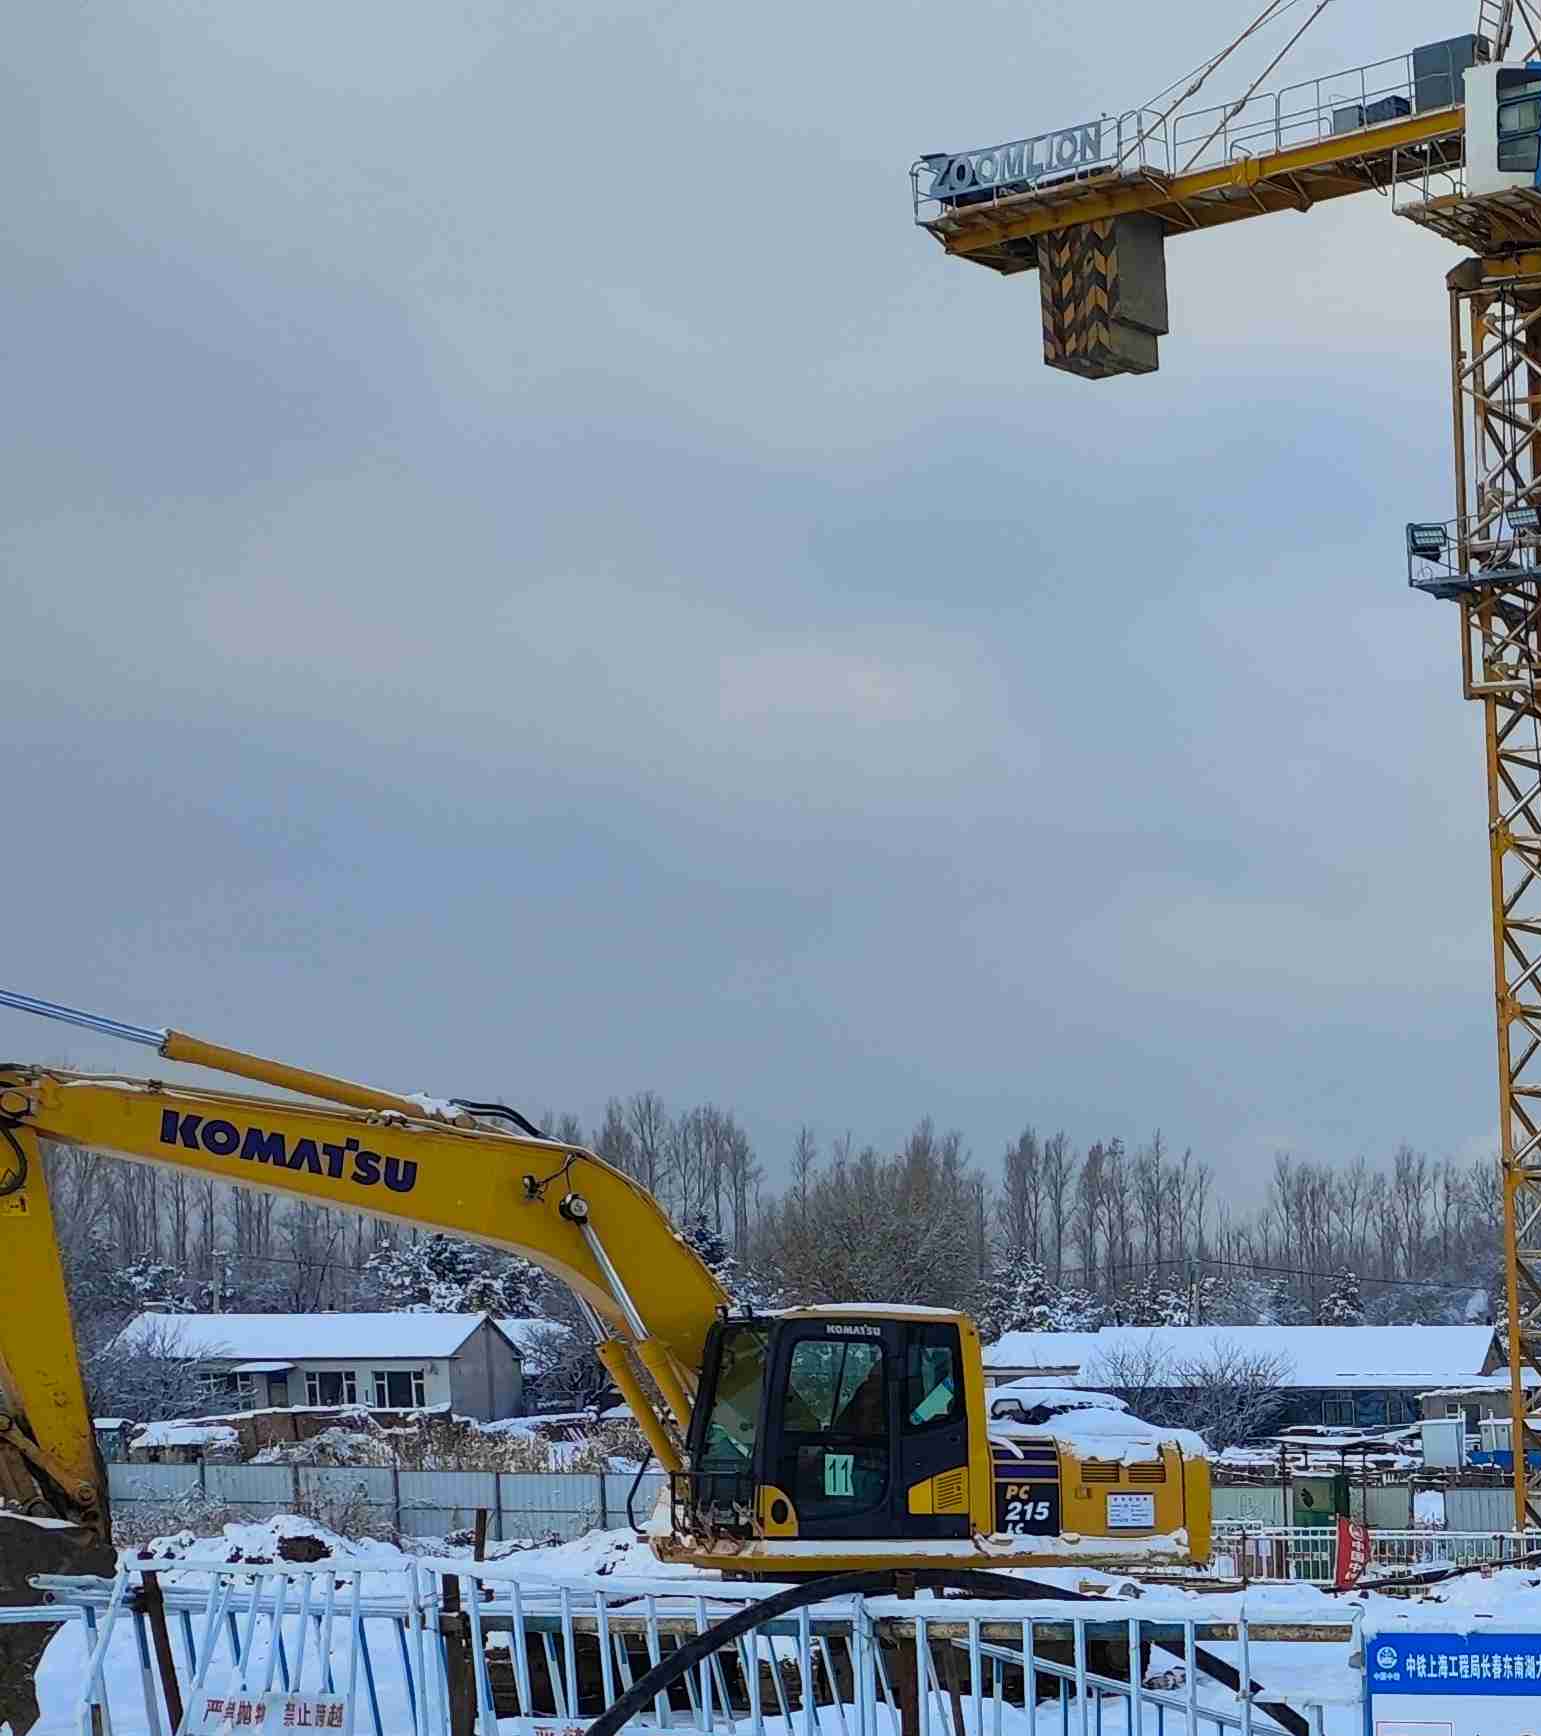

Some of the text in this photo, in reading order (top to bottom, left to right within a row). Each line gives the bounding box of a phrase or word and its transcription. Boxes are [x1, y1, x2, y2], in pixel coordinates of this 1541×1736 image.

[928, 122, 1101, 198] ZOOMLION
[160, 1109, 418, 1193] KOMATSU
[826, 1323, 881, 1336] KOMATSU
[828, 1458, 850, 1493] 11
[1005, 1485, 1031, 1500] PC
[1005, 1501, 1050, 1521] 215
